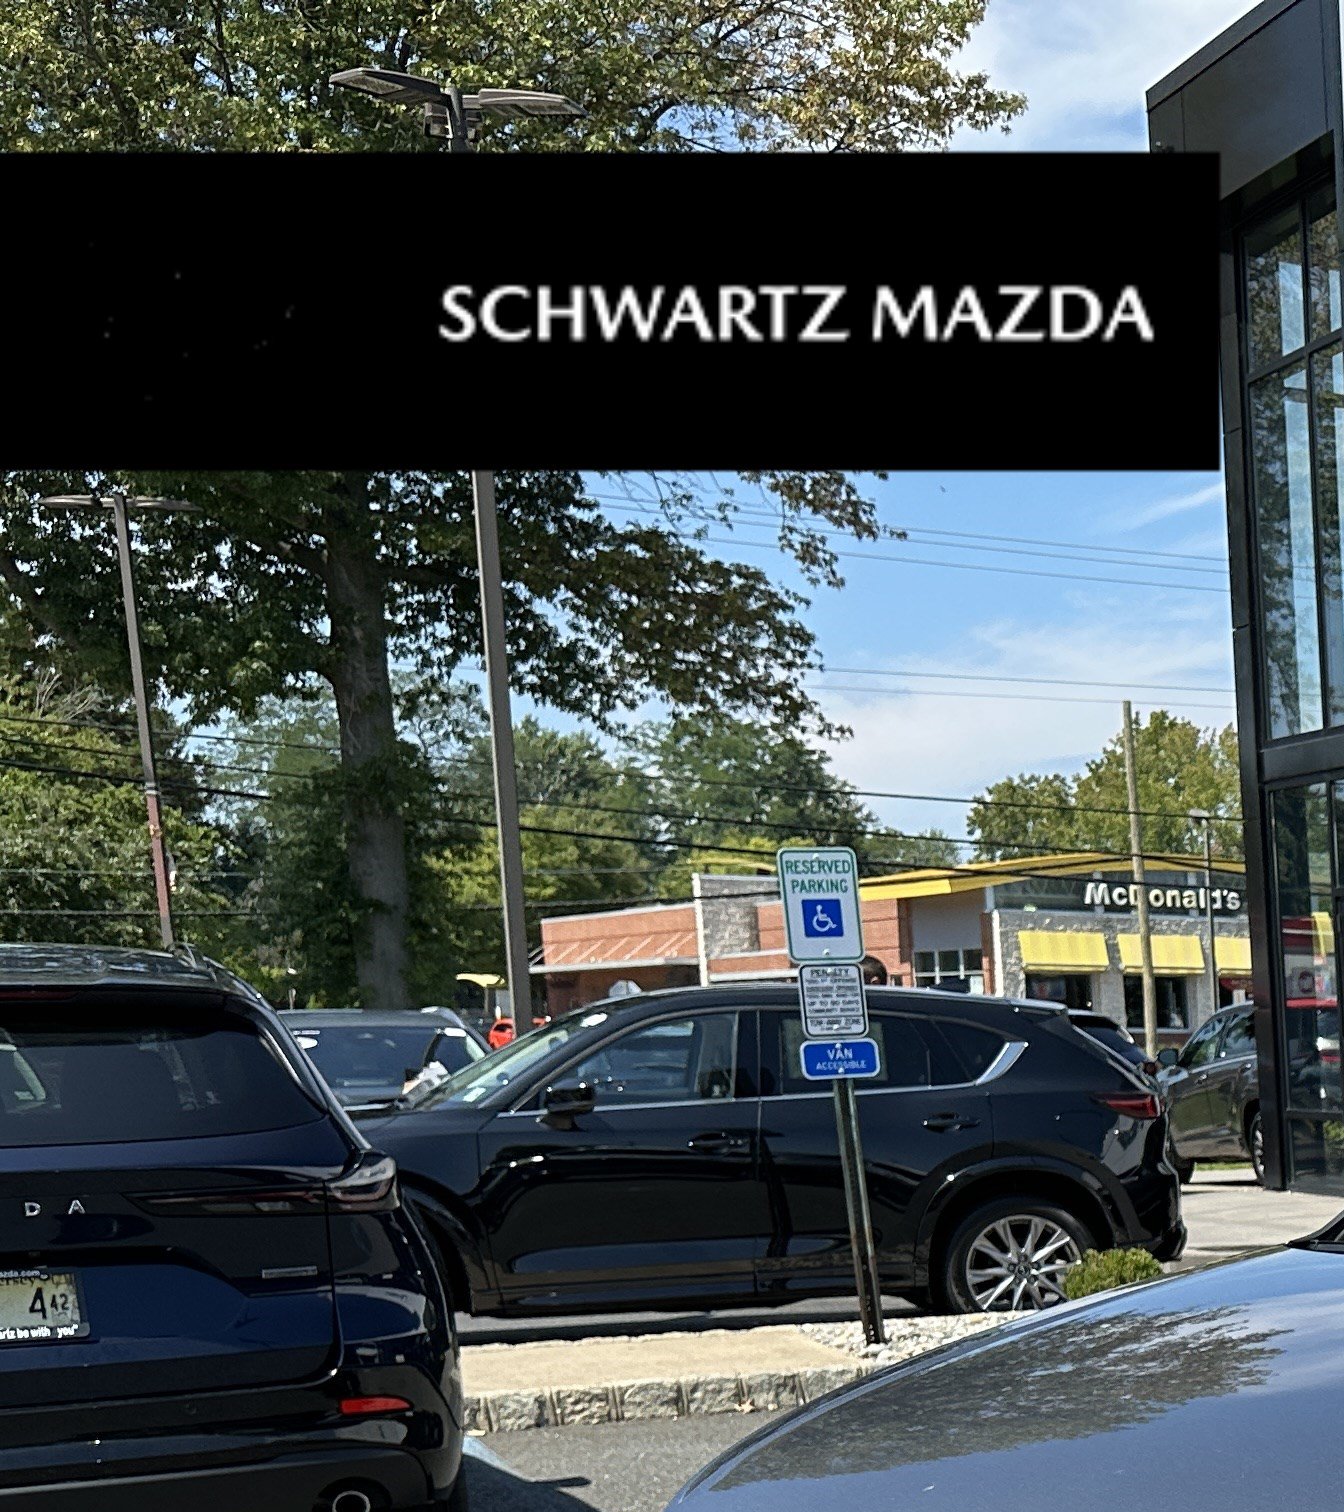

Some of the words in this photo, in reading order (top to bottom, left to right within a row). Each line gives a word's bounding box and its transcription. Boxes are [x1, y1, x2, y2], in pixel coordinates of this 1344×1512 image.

[785, 860, 851, 874] RESERVED
[791, 879, 848, 893] PARKING
[826, 1048, 853, 1060] VAN
[30, 1326, 51, 1338] with
